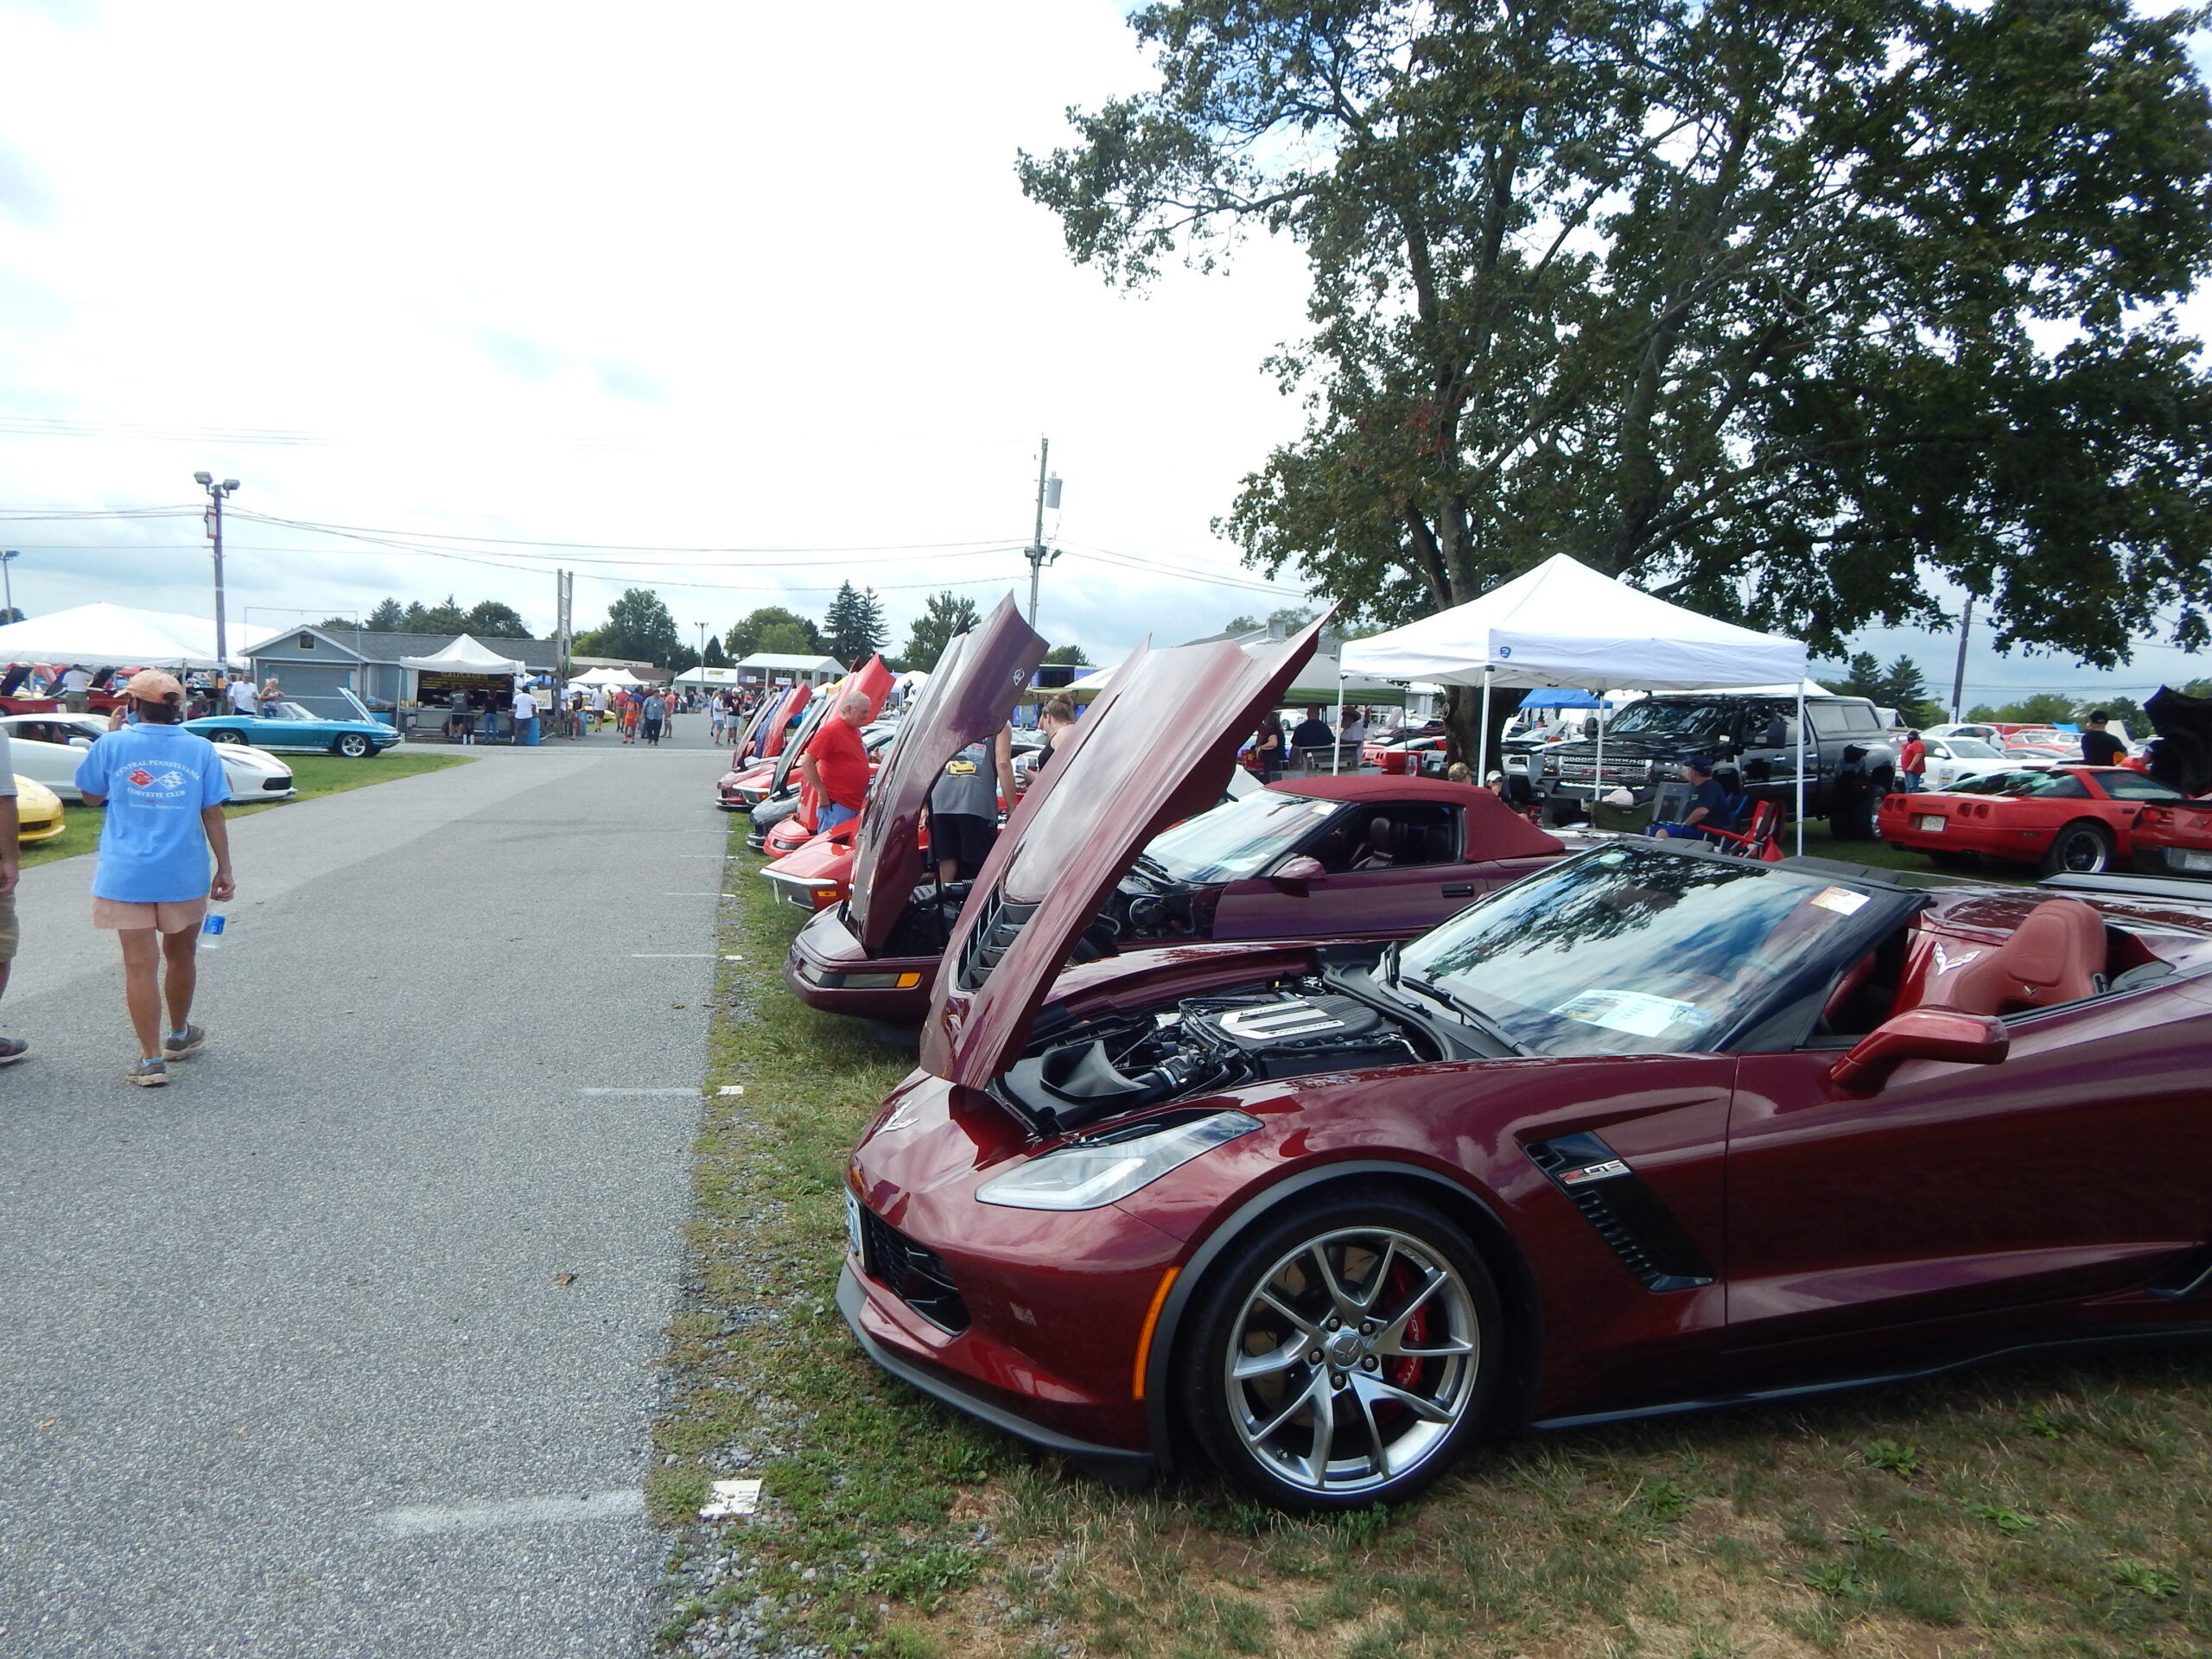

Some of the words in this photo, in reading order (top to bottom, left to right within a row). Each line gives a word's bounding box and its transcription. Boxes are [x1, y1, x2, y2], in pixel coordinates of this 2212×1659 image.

[441, 671, 490, 680] SAUSAGES
[116, 760, 149, 777] CENTRAL
[149, 760, 200, 780] PENNSYLVANIA
[127, 787, 164, 798] CORVETTE
